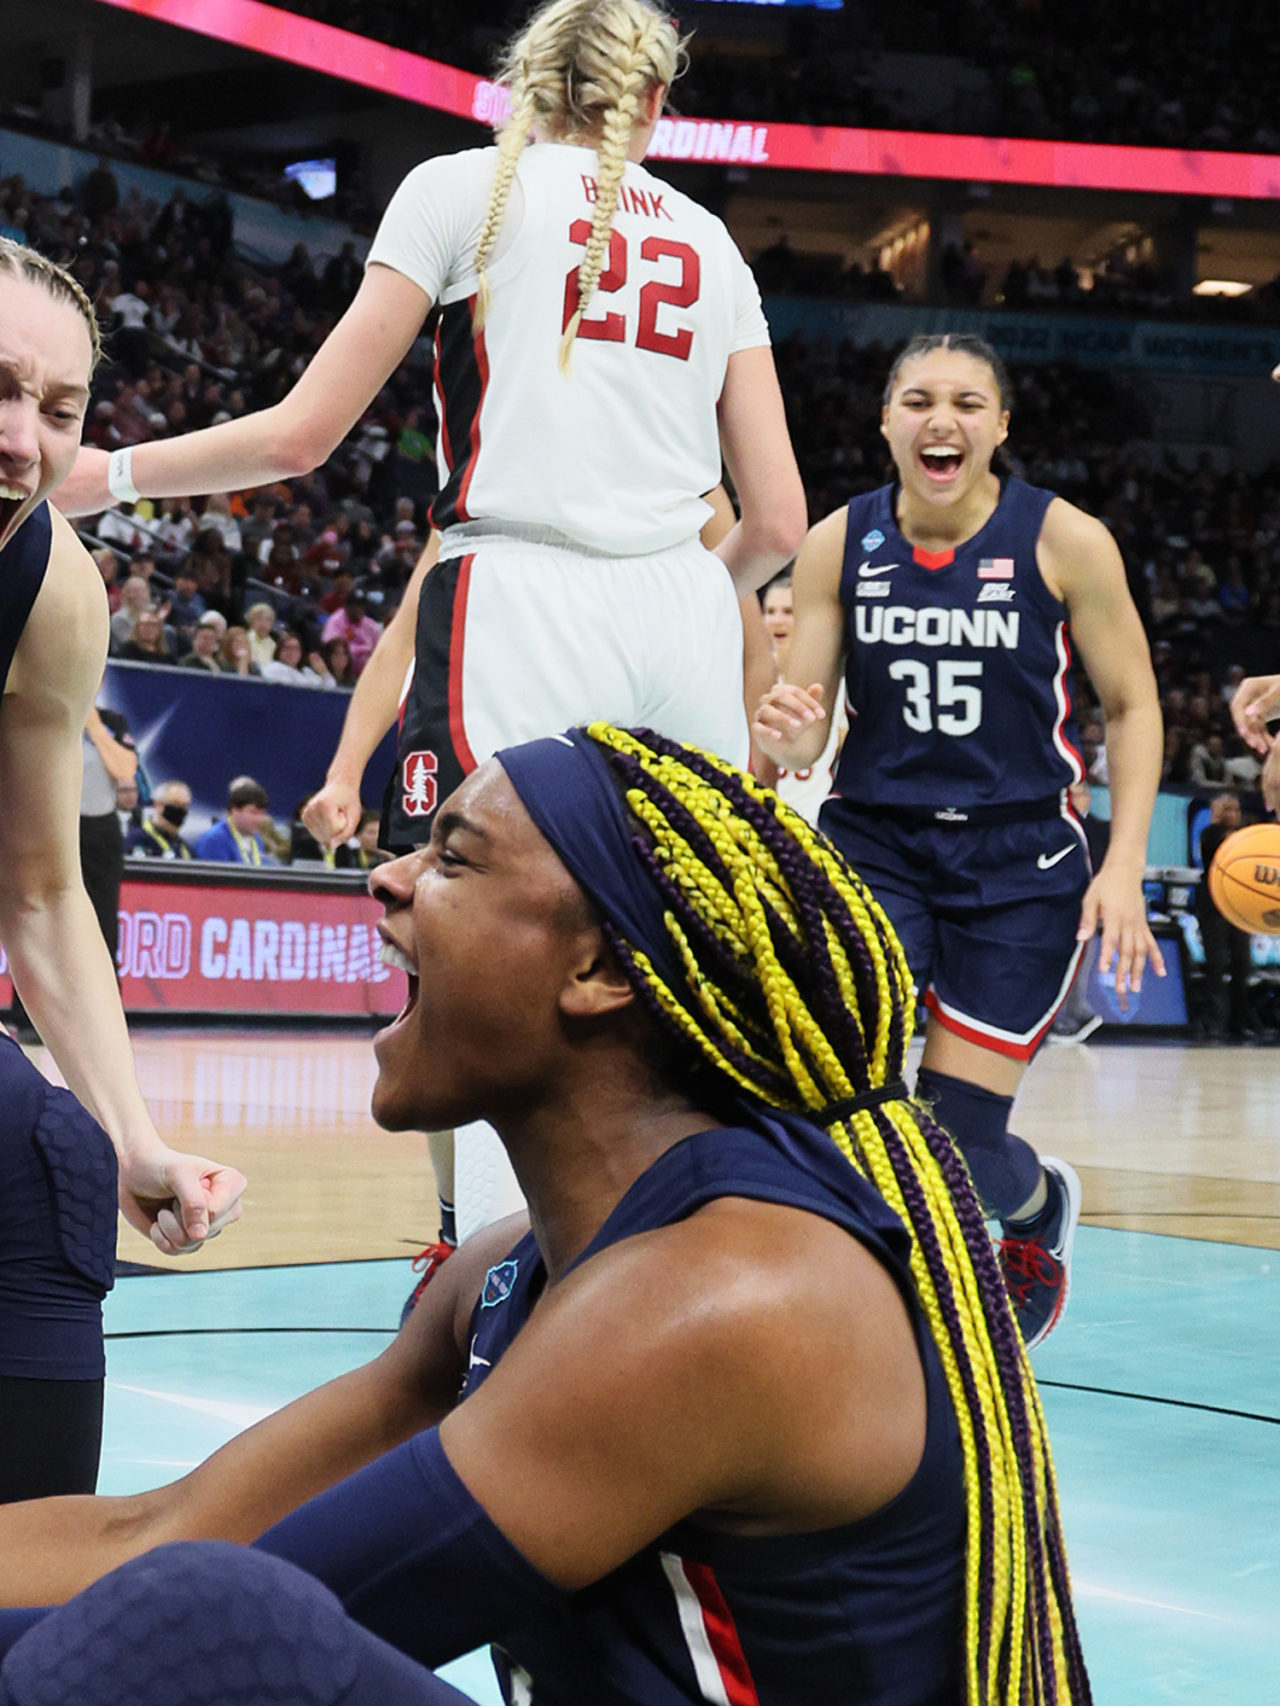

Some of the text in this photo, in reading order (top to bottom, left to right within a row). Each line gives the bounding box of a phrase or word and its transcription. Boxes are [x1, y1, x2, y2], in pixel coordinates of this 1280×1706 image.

[646, 118, 769, 162] RDINAL
[581, 174, 675, 222] BINK
[562, 218, 700, 361] 22
[855, 605, 1020, 650] UCONN
[888, 659, 983, 737] 35
[200, 917, 391, 984] CARDINAL
